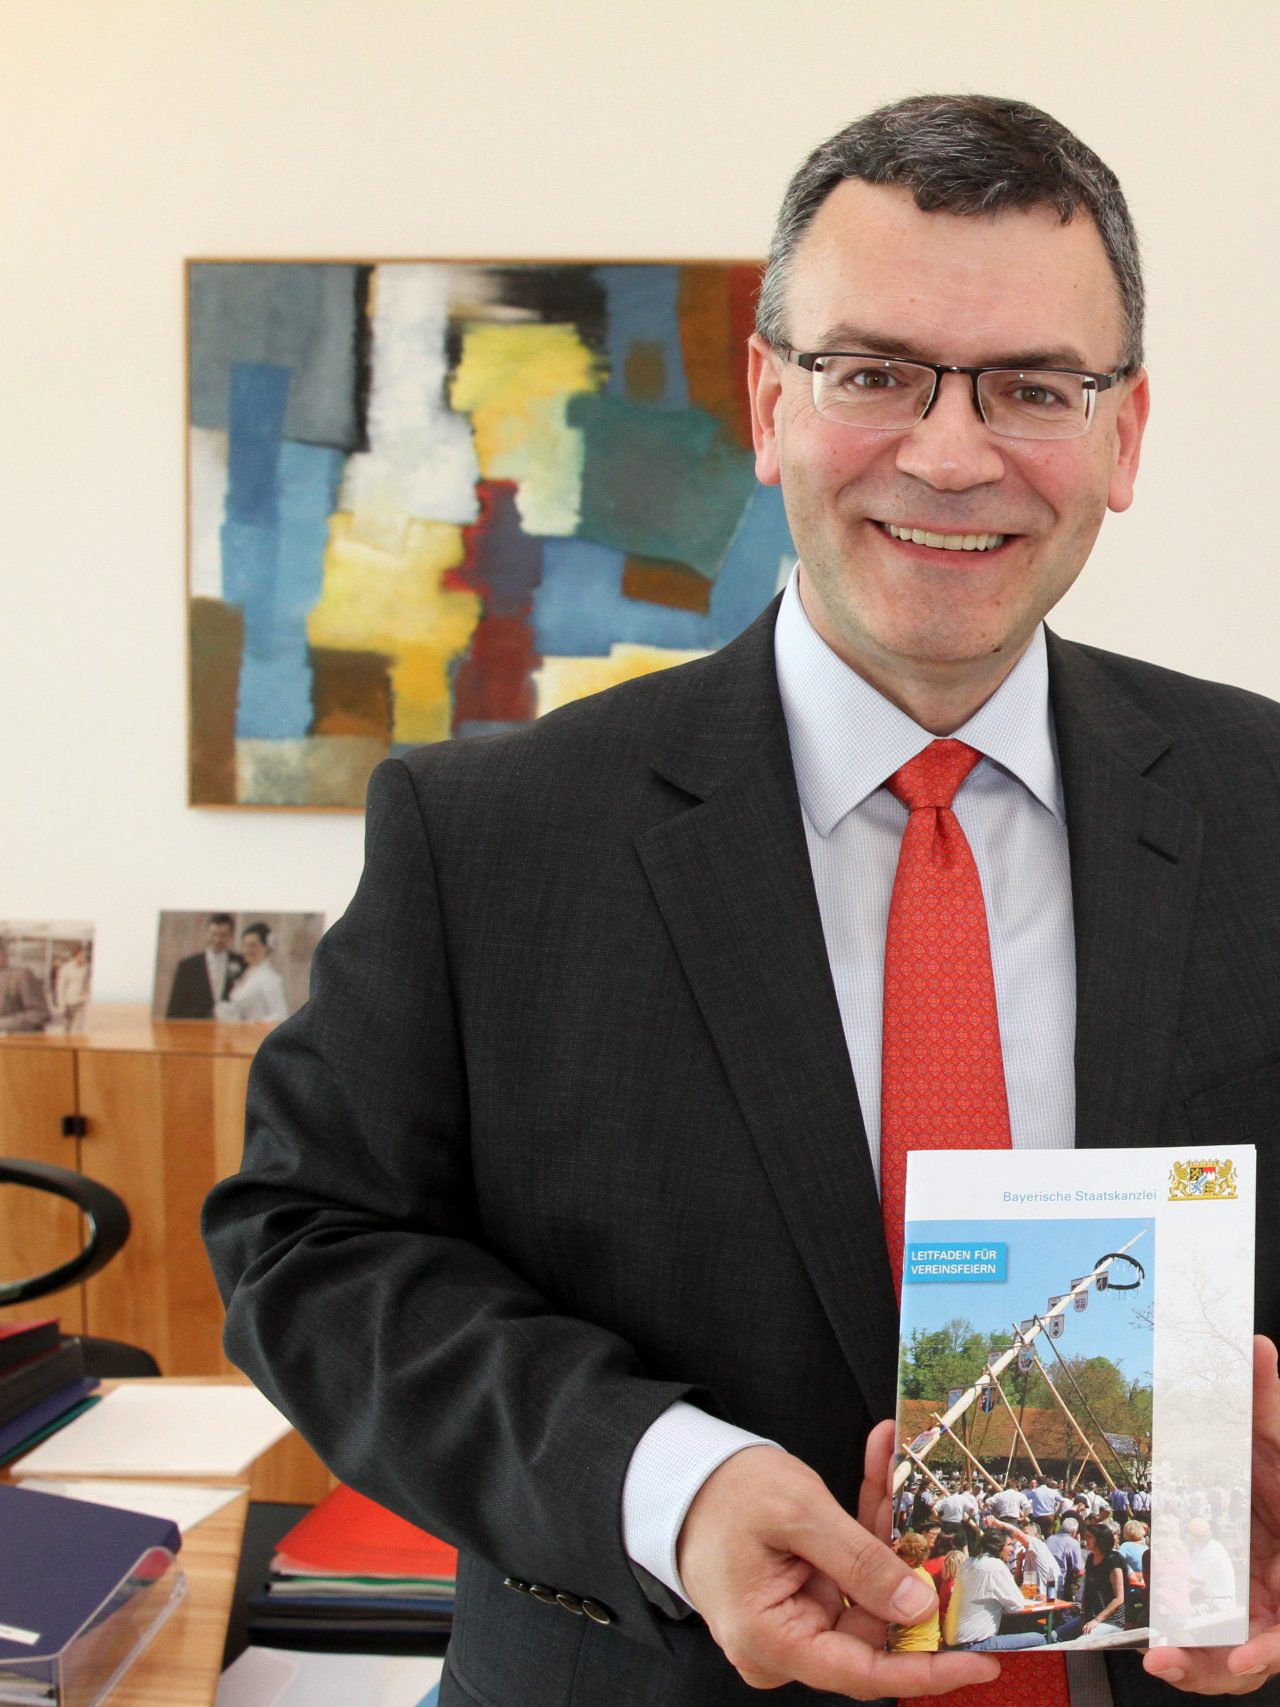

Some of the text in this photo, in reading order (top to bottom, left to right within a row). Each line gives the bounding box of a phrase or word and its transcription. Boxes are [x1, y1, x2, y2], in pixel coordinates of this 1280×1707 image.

[1002, 1188, 1158, 1204] Bayerische Staatskanzlei
[911, 1248, 997, 1261] LEITFADEN FÜR
[910, 1264, 997, 1275] VEREINSFEIERN
